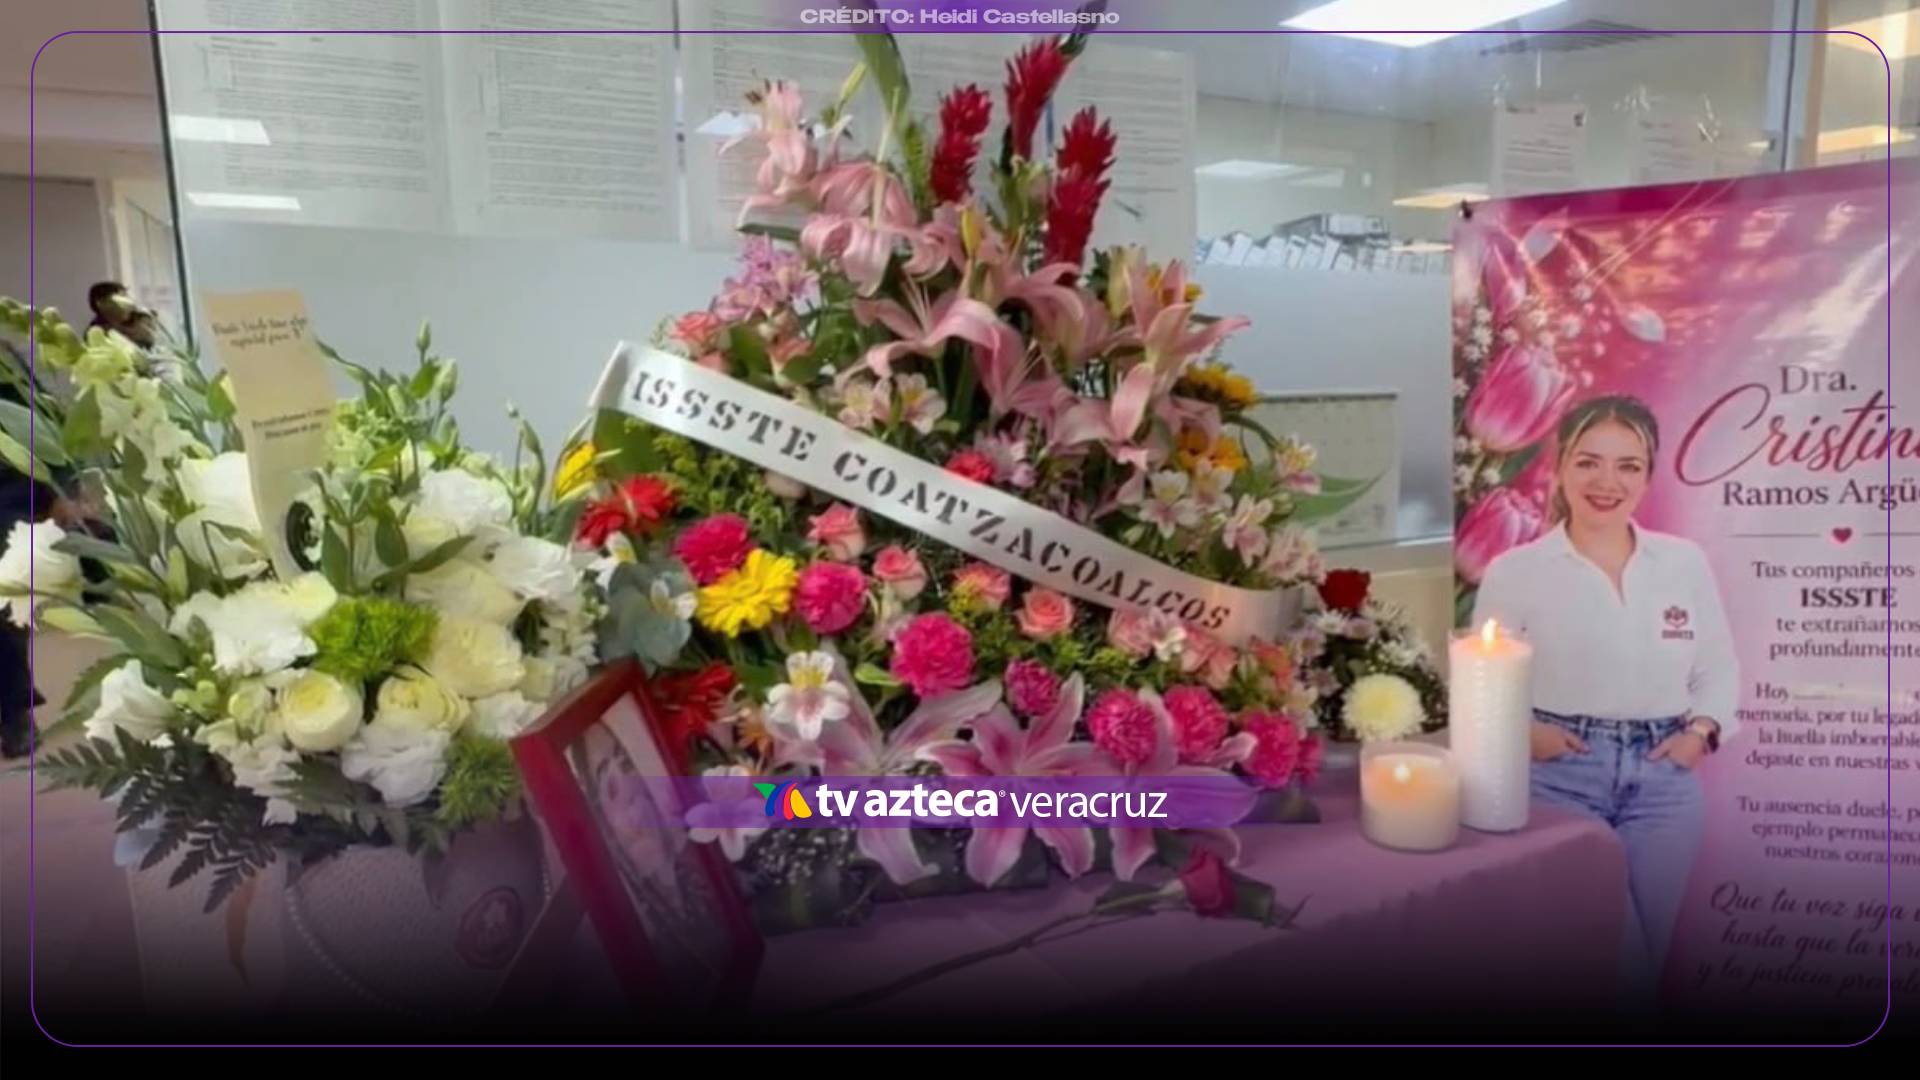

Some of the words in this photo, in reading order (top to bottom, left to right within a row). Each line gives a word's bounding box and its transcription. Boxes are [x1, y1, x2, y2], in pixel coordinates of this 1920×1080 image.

[1779, 365, 1857, 394] Dra.
[1674, 383, 1920, 487] Cristin
[631, 371, 818, 463] ISSSTE
[833, 451, 1232, 632] COATZACOALCOS
[1722, 480, 1829, 506] Ramos
[1838, 477, 1920, 511] Argü
[1752, 560, 1787, 578] Tus
[1792, 560, 1915, 583] compañeros
[1801, 587, 1897, 608] ISSSTE
[1777, 618, 1796, 632] te
[1756, 682, 1790, 703] Hoy
[1817, 709, 1846, 726] por
[1851, 710, 1869, 724] tu
[1873, 706, 1920, 729] legad
[1758, 727, 1773, 745] la
[1777, 727, 1826, 745] huella
[1745, 749, 1805, 770] dejaste
[1808, 754, 1830, 768] en
[1835, 753, 1911, 770] nuestras
[1736, 795, 1760, 813] Tu
[1764, 800, 1842, 816] ausencia
[1751, 820, 1824, 841] ejemplo
[1828, 825, 1920, 843] permanec
[1764, 844, 1841, 861] nuestros
[1844, 849, 1920, 866] corazon
[1709, 879, 1763, 917] Que
[1770, 886, 1800, 914] tu
[1720, 917, 1787, 949] hasta
